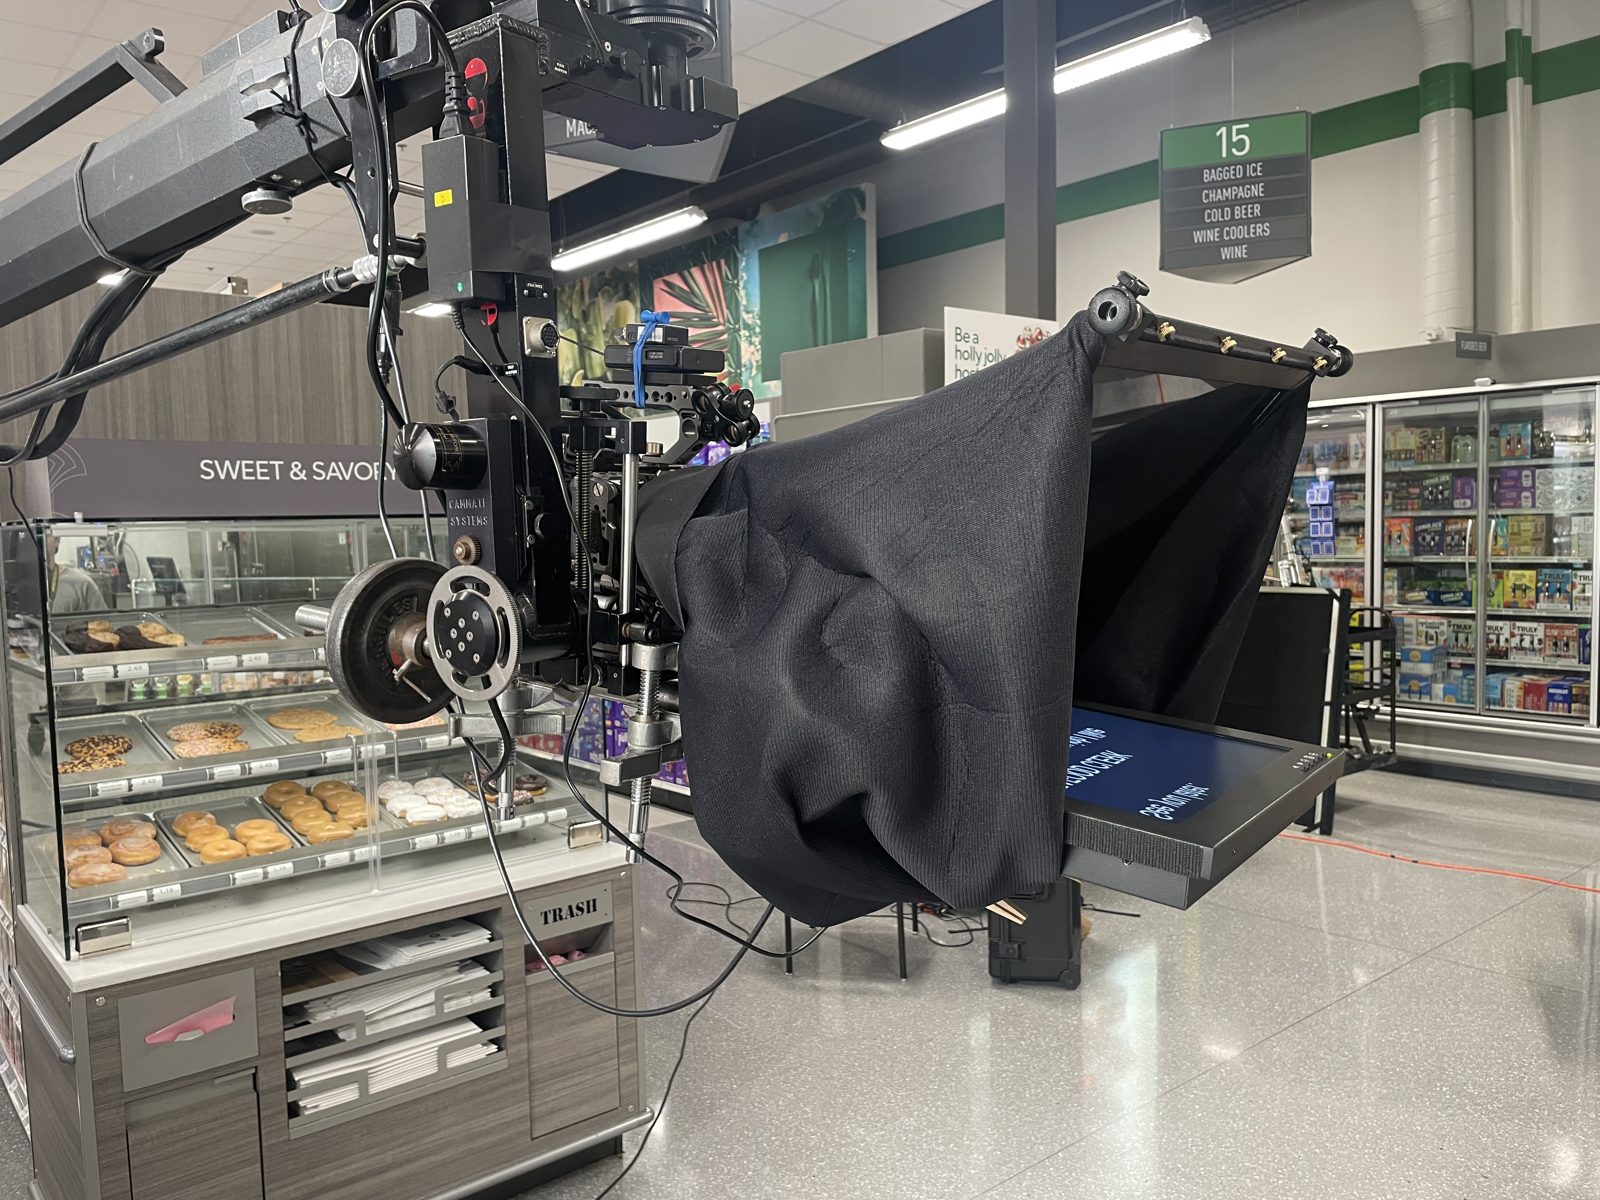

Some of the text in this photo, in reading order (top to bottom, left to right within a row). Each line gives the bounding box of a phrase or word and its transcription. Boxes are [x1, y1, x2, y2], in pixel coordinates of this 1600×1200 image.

[1215, 123, 1250, 158] 15
[1203, 162, 1263, 183] BAGGED ICE
[1202, 183, 1265, 204] CHAMPAGNE
[1204, 204, 1261, 223] COLD BEER
[1193, 222, 1271, 243] WINE COOLERS
[1220, 245, 1248, 260] WINE
[955, 326, 979, 344] Be a
[955, 344, 982, 366] holly
[200, 459, 284, 480] SWEET
[289, 461, 307, 481] &
[450, 515, 488, 526] SYSTEMS
[1517, 625, 1538, 633] TRULY
[540, 898, 598, 925] TRASH
